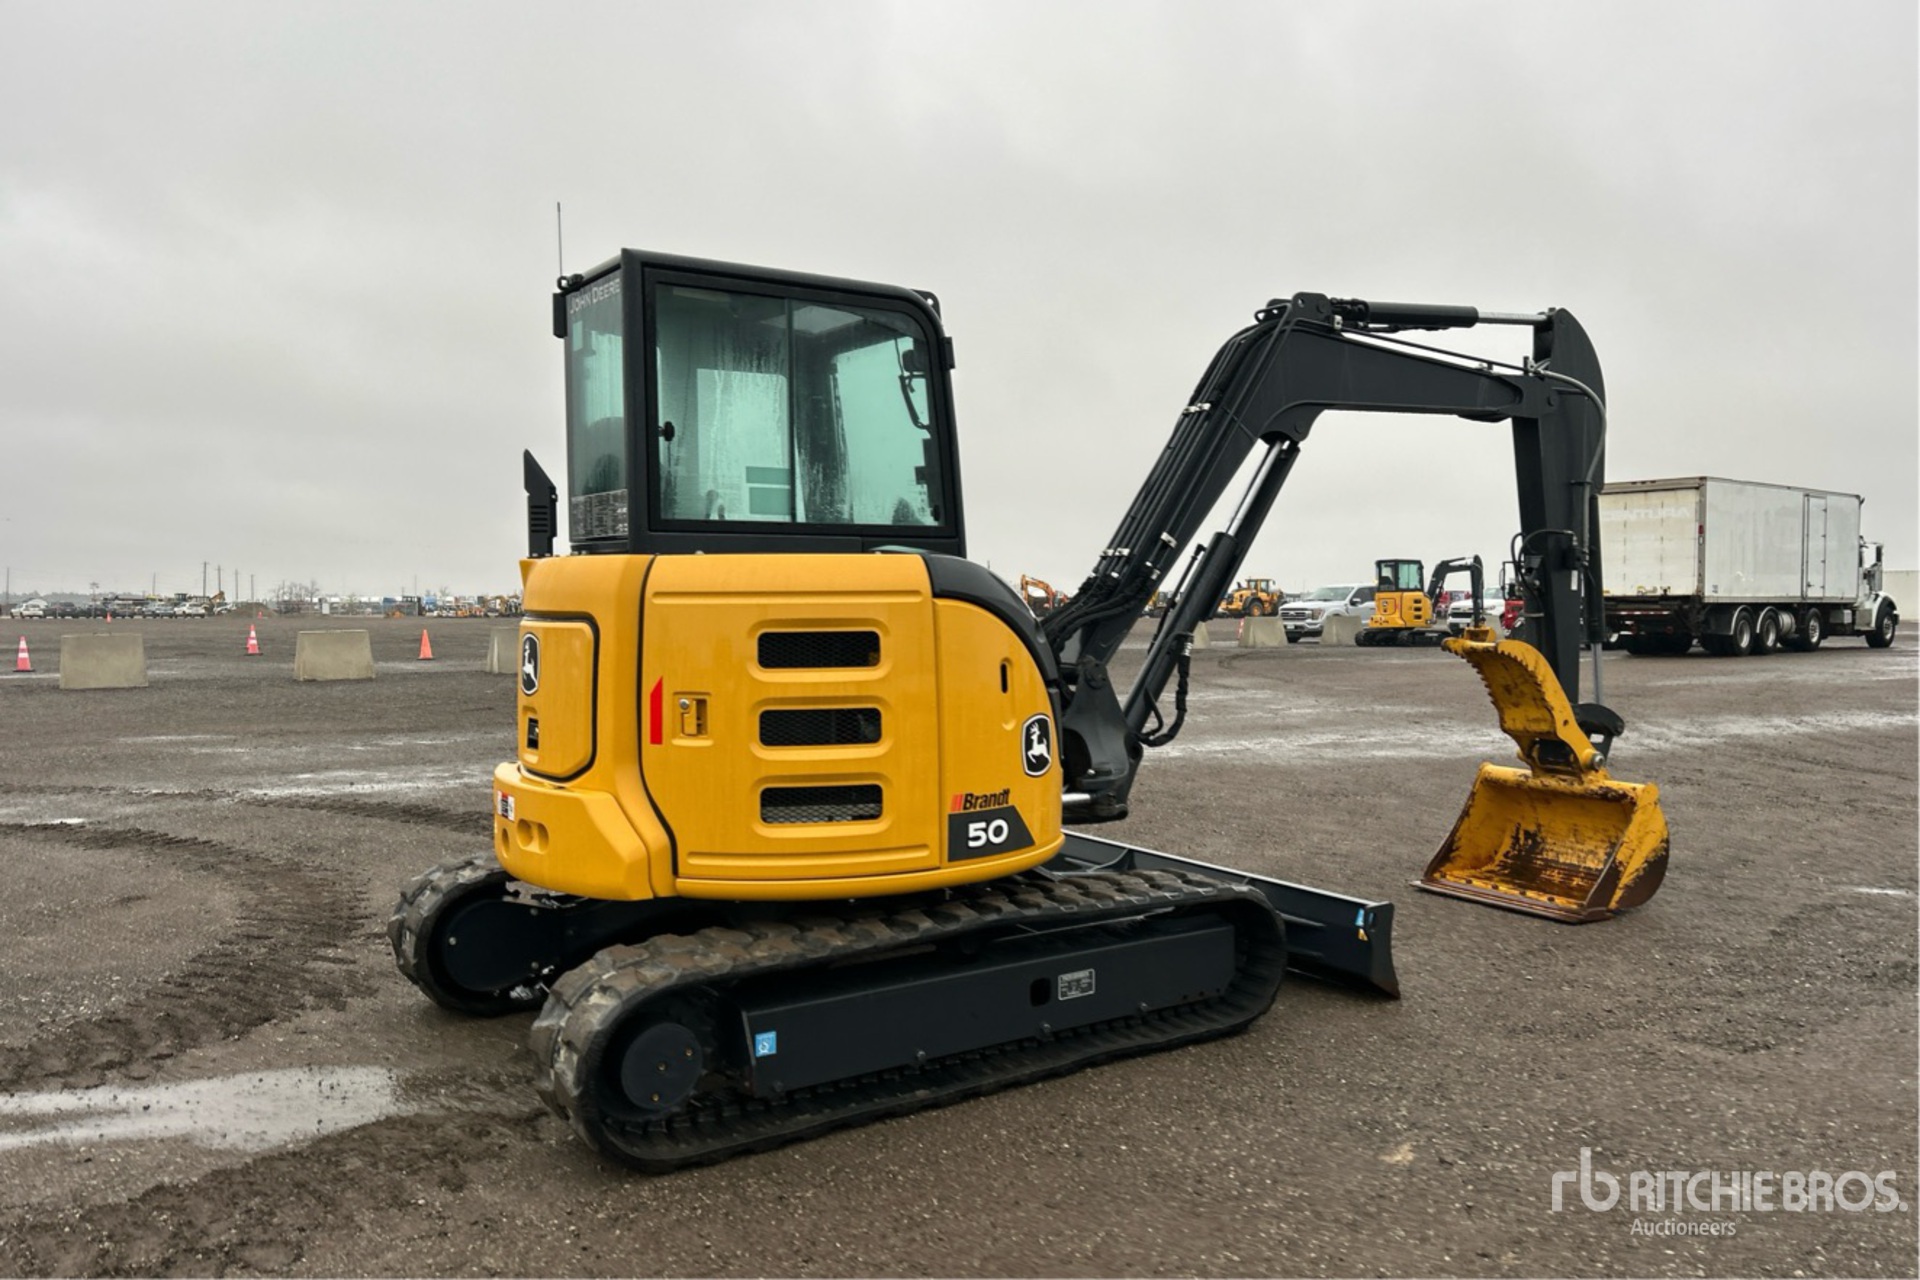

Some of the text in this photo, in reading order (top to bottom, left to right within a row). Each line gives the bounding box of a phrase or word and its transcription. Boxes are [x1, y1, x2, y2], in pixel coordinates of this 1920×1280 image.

[570, 278, 621, 314] JOHN DEERE
[962, 788, 1010, 810] Brandt
[968, 818, 1009, 848] 50
